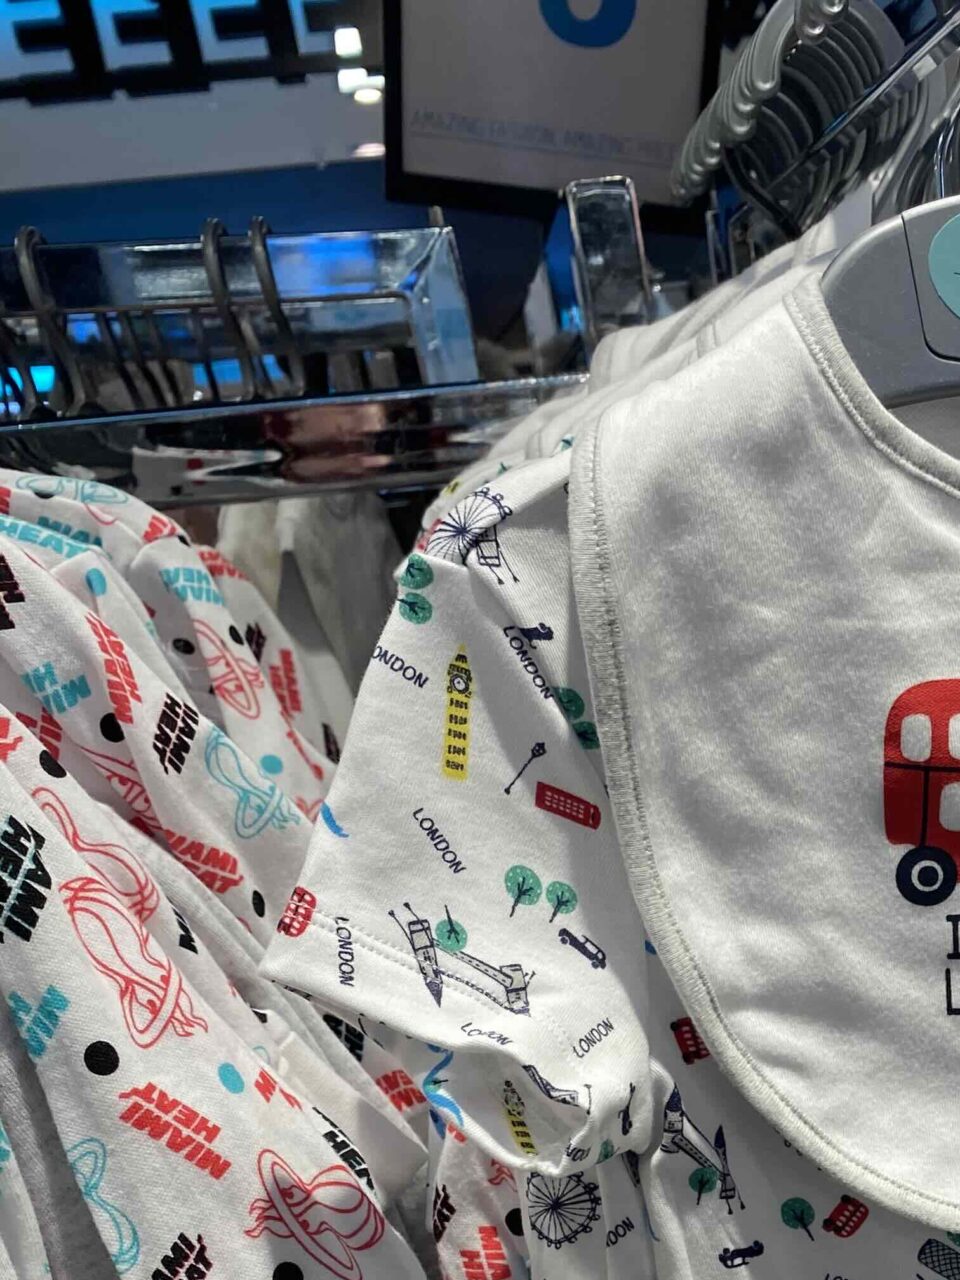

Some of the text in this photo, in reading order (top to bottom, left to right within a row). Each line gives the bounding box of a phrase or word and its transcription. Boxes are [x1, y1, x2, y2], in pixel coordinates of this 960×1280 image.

[370, 646, 429, 689] ONDON
[502, 625, 556, 700] LONDON
[152, 692, 183, 775] HEAT
[412, 807, 467, 875] LONDON
[335, 915, 355, 988] LONDON
[572, 1017, 616, 1059] LONDON
[118, 1082, 222, 1144] HEAT
[118, 1100, 233, 1180] MIAMI
